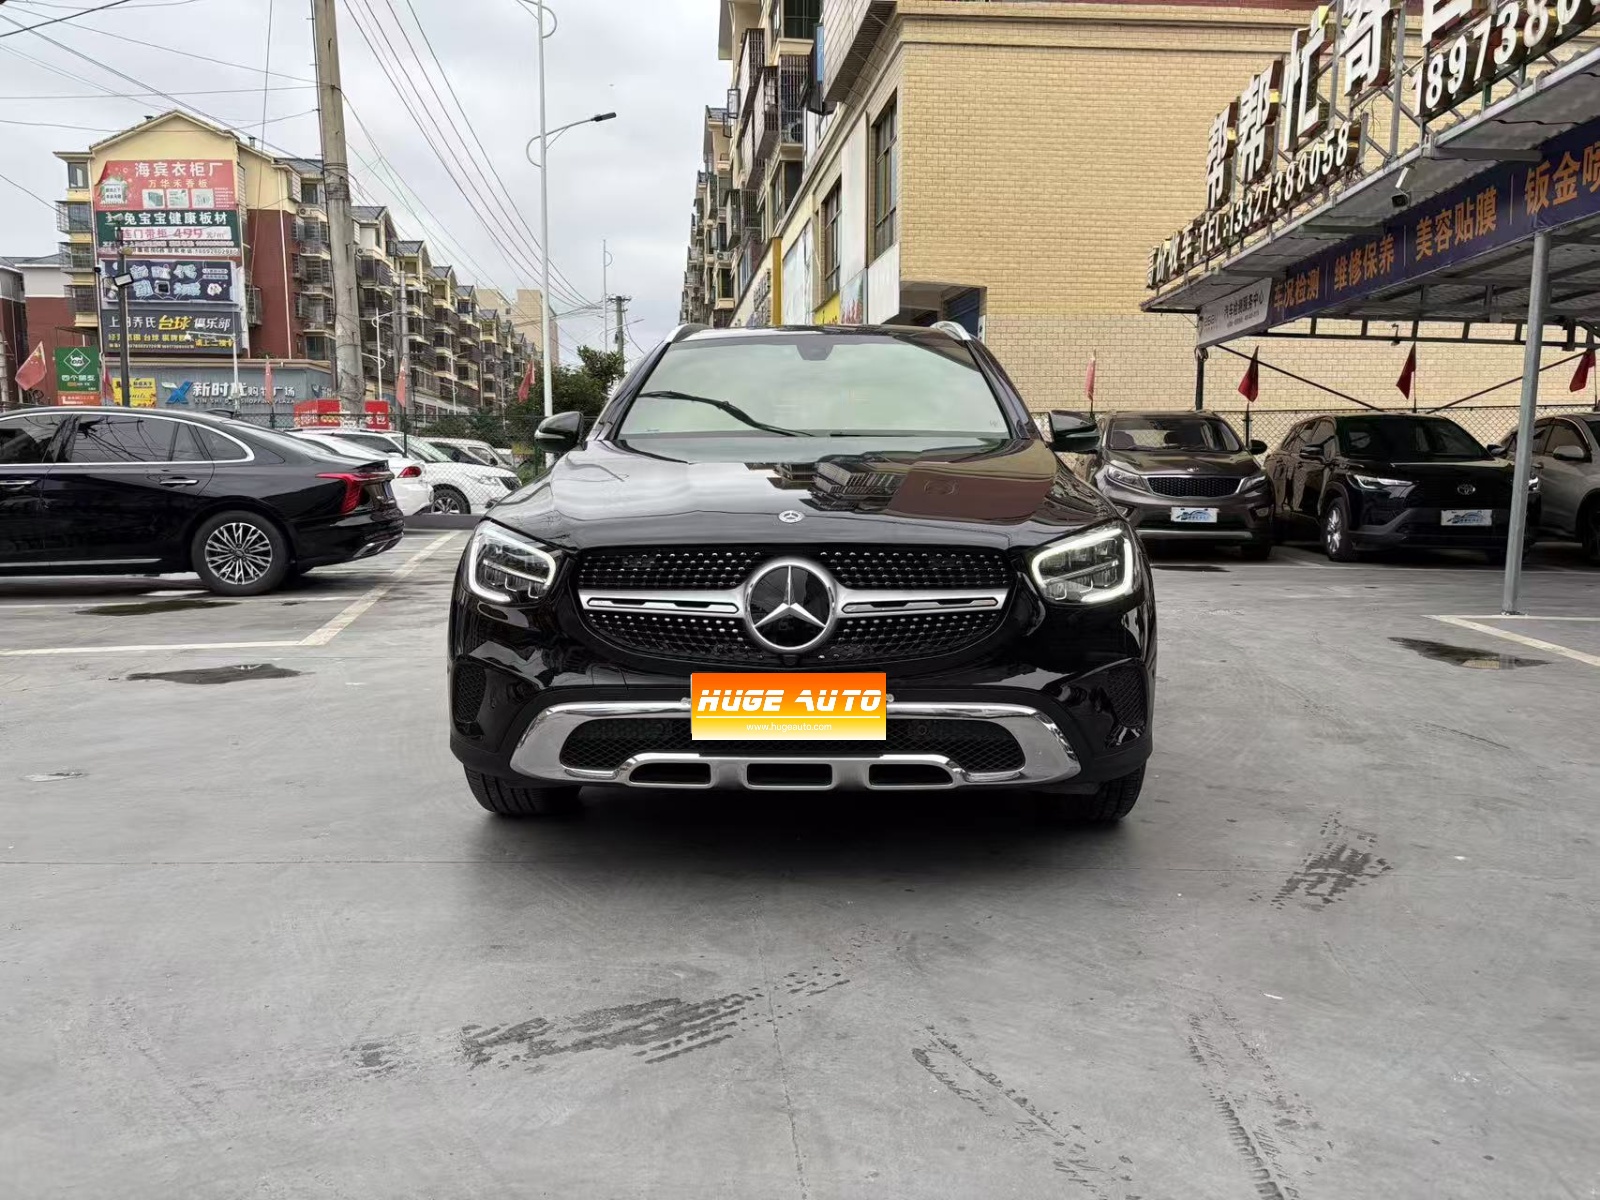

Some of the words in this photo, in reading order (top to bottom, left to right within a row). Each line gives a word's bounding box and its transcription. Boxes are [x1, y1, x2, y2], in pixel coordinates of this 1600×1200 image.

[134, 161, 223, 177] 海宾衣柜厂
[124, 211, 229, 225] 兔宝宝健康板材
[173, 228, 203, 239] 499
[1333, 233, 1395, 292] 维修保养
[1415, 185, 1498, 262] 美容贴膜
